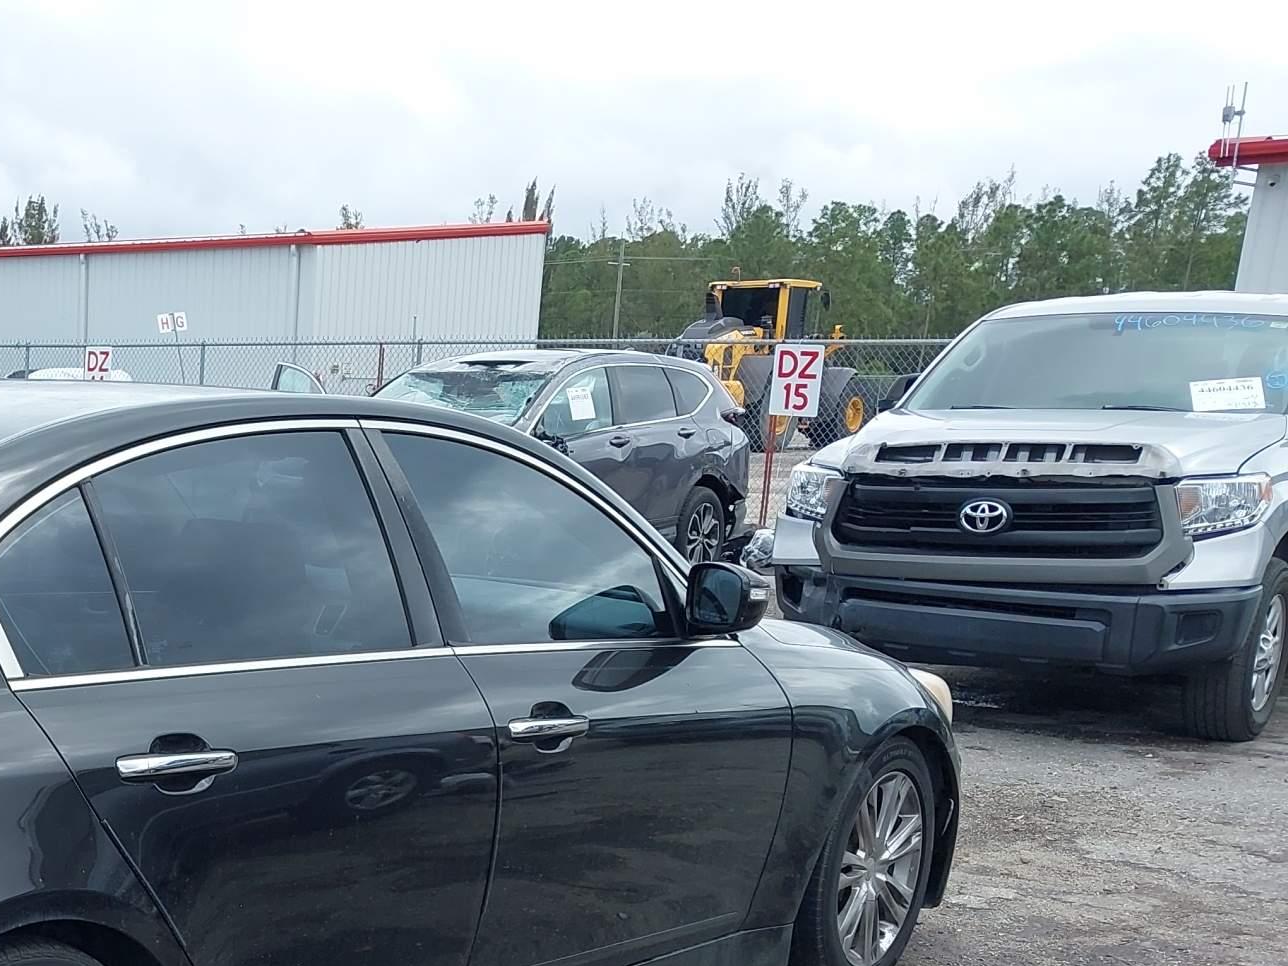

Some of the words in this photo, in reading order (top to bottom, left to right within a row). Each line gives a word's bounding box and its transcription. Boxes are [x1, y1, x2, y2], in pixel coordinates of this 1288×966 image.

[161, 317, 170, 330] H
[176, 315, 185, 328] G
[87, 350, 110, 372] DZ
[777, 350, 820, 379] DZ
[783, 383, 809, 411] 15
